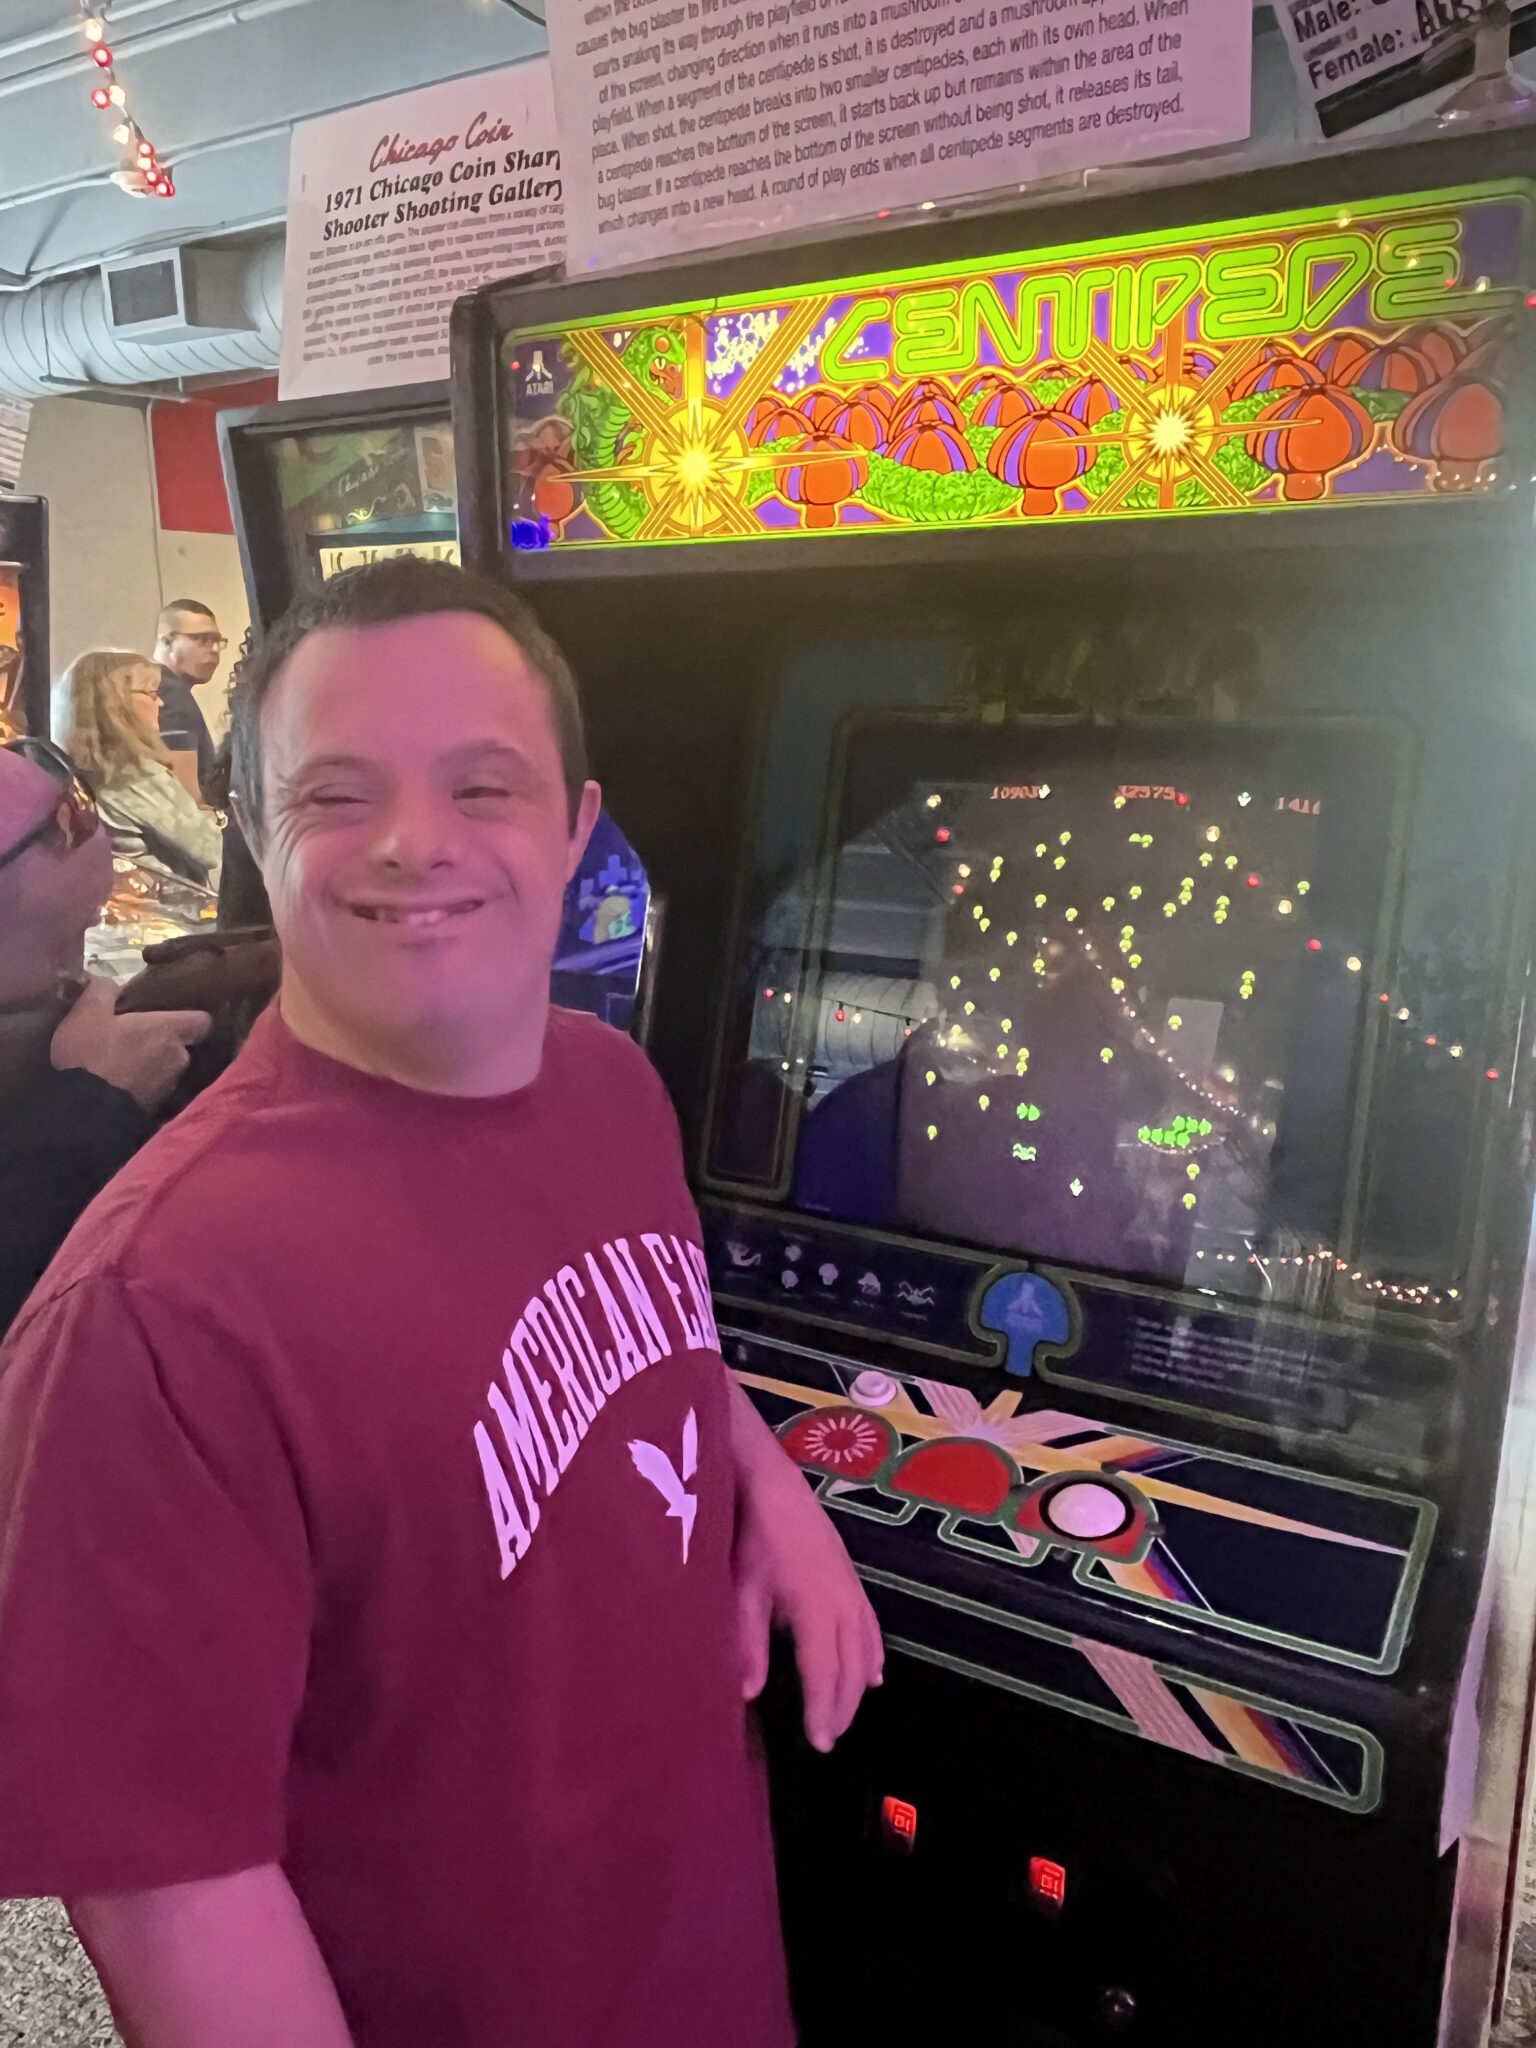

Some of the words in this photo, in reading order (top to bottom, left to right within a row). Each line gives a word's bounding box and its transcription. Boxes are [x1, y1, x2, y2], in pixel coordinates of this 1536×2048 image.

[611, 26, 626, 44] the
[628, 20, 648, 39] bug
[622, 45, 660, 69] snaking
[663, 38, 675, 55] its
[701, 15, 743, 44] through
[746, 11, 764, 30] the
[622, 131, 650, 151] When
[679, 117, 696, 135] the
[699, 102, 751, 130] centipede
[753, 91, 792, 115] breaks
[795, 84, 817, 104] into
[819, 80, 842, 99] two
[845, 66, 889, 92] smaller
[893, 49, 969, 80] centipedes,
[973, 36, 1006, 62] each
[1010, 29, 1038, 53] with
[1043, 25, 1059, 46] its
[1064, 19, 1094, 41] own
[1098, 5, 1139, 34] head.
[1144, 0, 1188, 23] When
[636, 99, 665, 119] When
[668, 96, 674, 111] a
[724, 75, 735, 95] of
[737, 72, 755, 90] the
[759, 54, 815, 85] centipede
[818, 51, 828, 70] is
[865, 37, 873, 56] it
[877, 37, 887, 54] is
[891, 16, 955, 50] destroyed
[959, 8, 984, 34] and
[989, 11, 997, 27] a
[667, 56, 715, 83] changing
[717, 40, 765, 68] direction
[768, 32, 800, 53] when
[802, 25, 810, 44] it
[813, 20, 839, 40] runs
[843, 12, 866, 32] into
[870, 10, 877, 26] a
[1308, 29, 1404, 90] Female:
[370, 133, 459, 172] Chicago
[465, 111, 513, 150] Coin
[598, 171, 604, 184] a
[606, 156, 653, 181] centipede
[697, 141, 714, 157] the
[717, 131, 756, 153] bottom
[759, 123, 769, 143] of
[772, 121, 790, 140] the
[794, 111, 837, 134] screen,
[840, 104, 847, 123] it
[851, 97, 886, 121] starts
[889, 87, 921, 111] back
[924, 86, 941, 106] up
[945, 77, 966, 99] but
[971, 67, 1024, 93] remains
[1074, 49, 1096, 70] the
[1101, 43, 1134, 65] area
[1139, 33, 1154, 56] of
[1158, 32, 1182, 52] the
[598, 193, 615, 211] bug
[666, 179, 671, 193] a
[674, 163, 725, 191] centipede
[728, 155, 771, 178] reaches
[774, 149, 792, 167] the
[795, 140, 837, 163] bottom
[840, 132, 851, 152] of
[855, 130, 875, 150] the
[879, 121, 920, 144] screen
[924, 105, 972, 133] without
[976, 101, 1013, 123] being
[1018, 89, 1051, 114] shot,
[1056, 85, 1064, 104] it
[1069, 76, 1129, 102] releases
[1134, 69, 1151, 89] its
[1157, 60, 1182, 84] tail,
[325, 185, 362, 213] 1971
[369, 170, 443, 203] Chicago
[449, 157, 496, 183] Coin
[627, 206, 668, 228] changes
[671, 200, 691, 217] into
[694, 199, 700, 213] a
[761, 179, 769, 198] A
[772, 171, 804, 196] round
[808, 167, 819, 188] of
[823, 165, 846, 189] play
[850, 156, 880, 179] ends
[883, 152, 917, 171] when
[920, 143, 934, 164] all
[938, 130, 1003, 160] centipede
[1008, 116, 1073, 148] segments
[1079, 112, 1101, 131] are
[1106, 92, 1184, 126] destroyed.
[323, 210, 389, 241] Shooter
[394, 191, 483, 223] Shooting
[820, 217, 1516, 385] CENTIPEDE
[473, 1237, 672, 1580] AMERICAN
